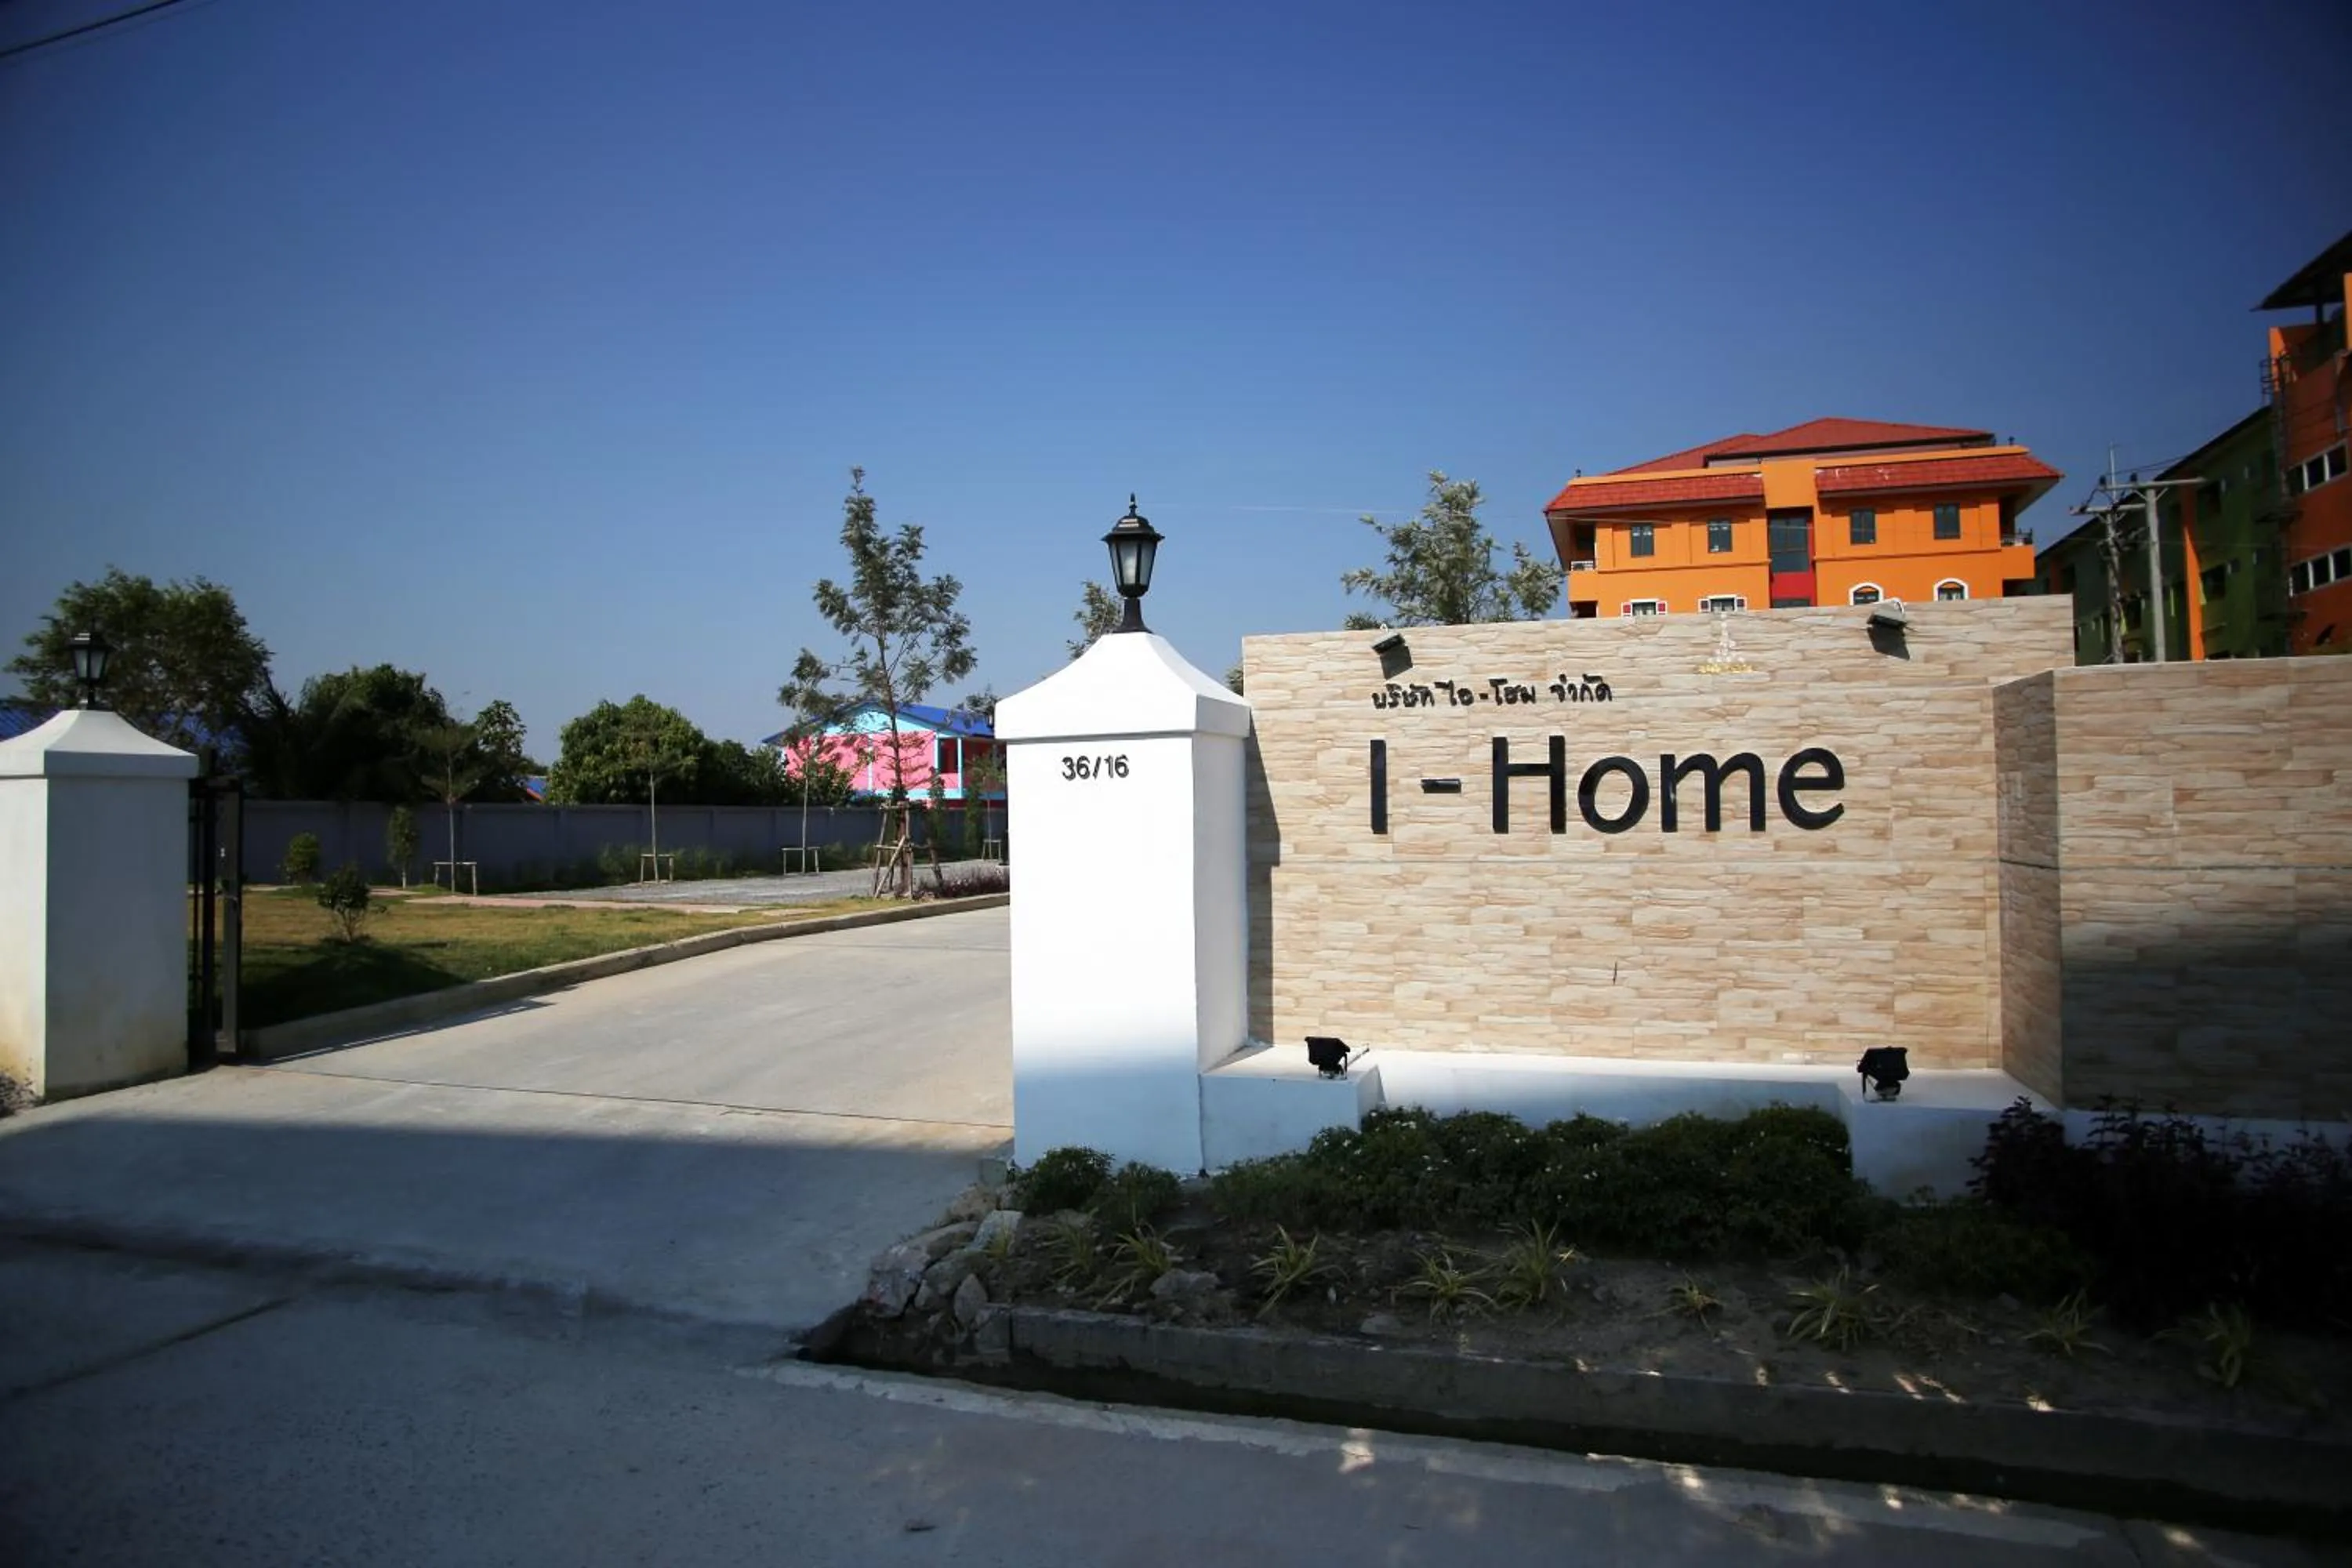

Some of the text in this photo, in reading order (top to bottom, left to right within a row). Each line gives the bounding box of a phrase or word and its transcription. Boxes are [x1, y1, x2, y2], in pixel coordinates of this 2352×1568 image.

[1371, 683, 1436, 710] บริษัท
[1548, 673, 1613, 703] จำกัด
[1062, 754, 1130, 782] 36/16
